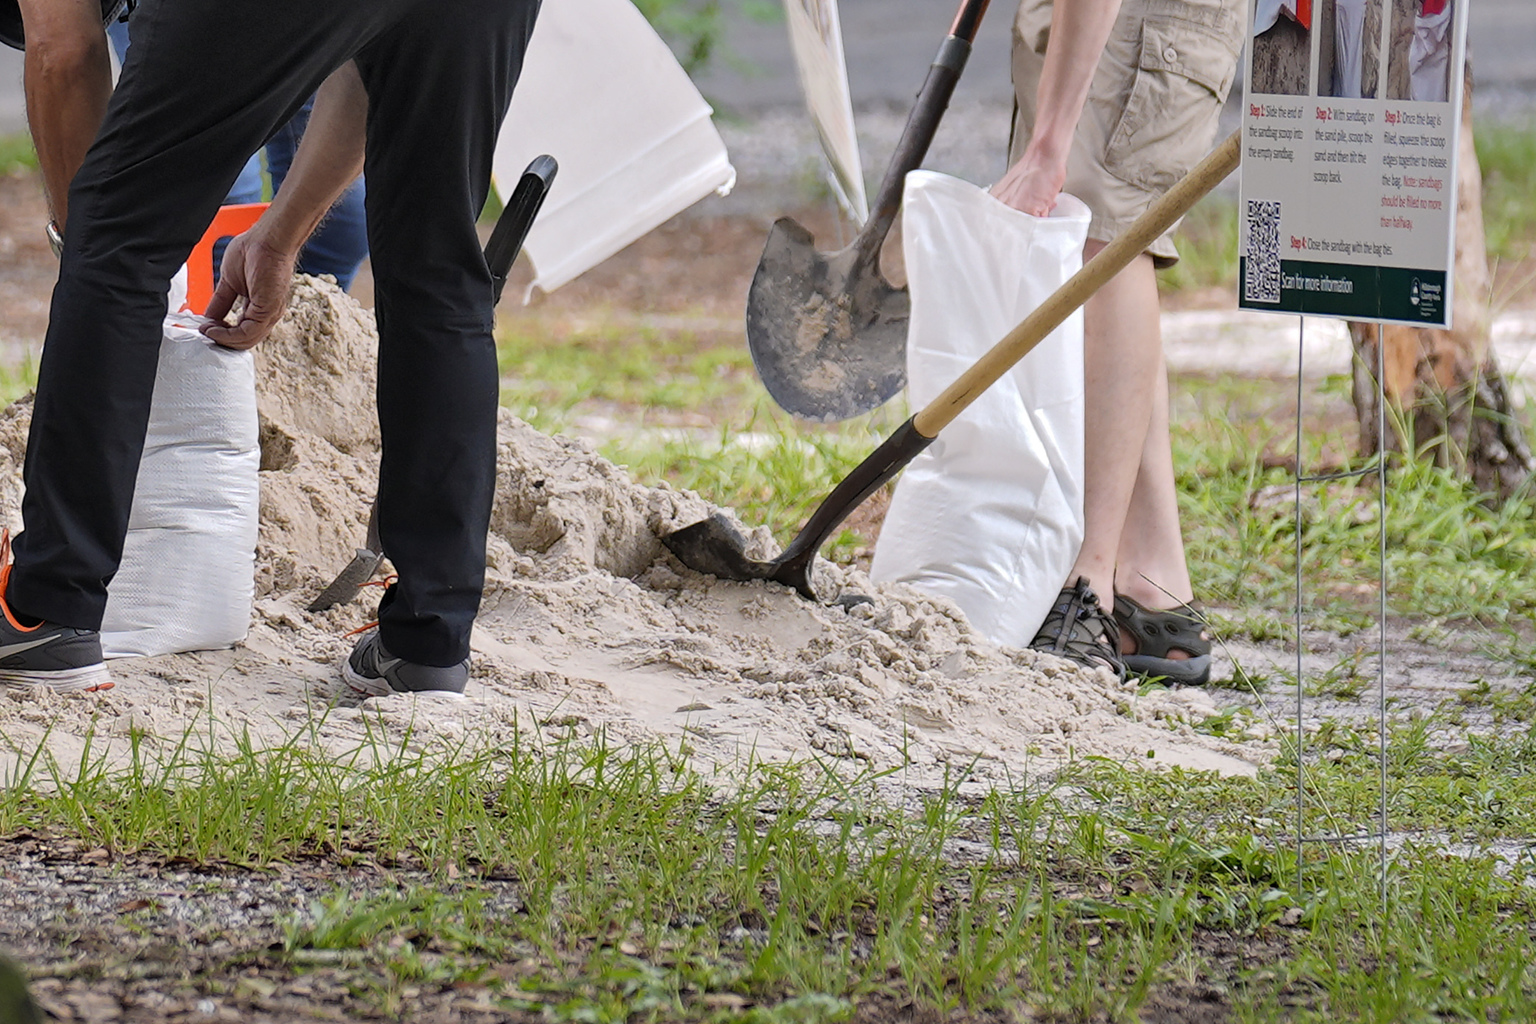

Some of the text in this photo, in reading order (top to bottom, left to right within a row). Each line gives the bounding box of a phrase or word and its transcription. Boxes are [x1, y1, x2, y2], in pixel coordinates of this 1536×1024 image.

[1250, 103, 1261, 120] Step
[1265, 105, 1278, 118] Slide
[1278, 105, 1287, 118] the
[1287, 106, 1297, 119] end
[1298, 106, 1304, 119] of
[1316, 106, 1327, 123] Step
[1333, 108, 1345, 121] With
[1346, 109, 1368, 125] sandbag
[1368, 112, 1375, 122] on
[1385, 109, 1396, 127] Step
[1402, 111, 1416, 125] Once
[1416, 112, 1425, 125] the
[1426, 112, 1437, 128] bag
[1437, 114, 1442, 126] is
[1249, 124, 1304, 142] the sandbag scoop into
[1315, 128, 1324, 141] the
[1324, 128, 1336, 141] sand
[1348, 132, 1364, 145] scoop
[1364, 130, 1373, 144] the
[1399, 135, 1420, 148] squeeze
[1420, 133, 1430, 146] the
[1430, 137, 1446, 150] scoop
[1248, 145, 1257, 158] the
[1257, 147, 1273, 162] empty
[1314, 149, 1326, 162] sand
[1327, 149, 1336, 162] and
[1337, 150, 1349, 163] then
[1358, 151, 1367, 164] the
[1382, 152, 1448, 169] edges together to release
[1313, 171, 1328, 185] scoop
[1382, 173, 1391, 186] the
[1418, 176, 1443, 192] sandbags
[1381, 193, 1442, 211] should be filled no more
[1380, 215, 1392, 228] than
[1290, 234, 1301, 252] Step
[1307, 237, 1320, 251] Close
[1321, 239, 1330, 251] the
[1330, 239, 1351, 256] sandbag
[1352, 240, 1363, 253] with
[1363, 241, 1372, 254] the
[1373, 241, 1382, 257] bag
[1281, 271, 1354, 294] Scan for more information
